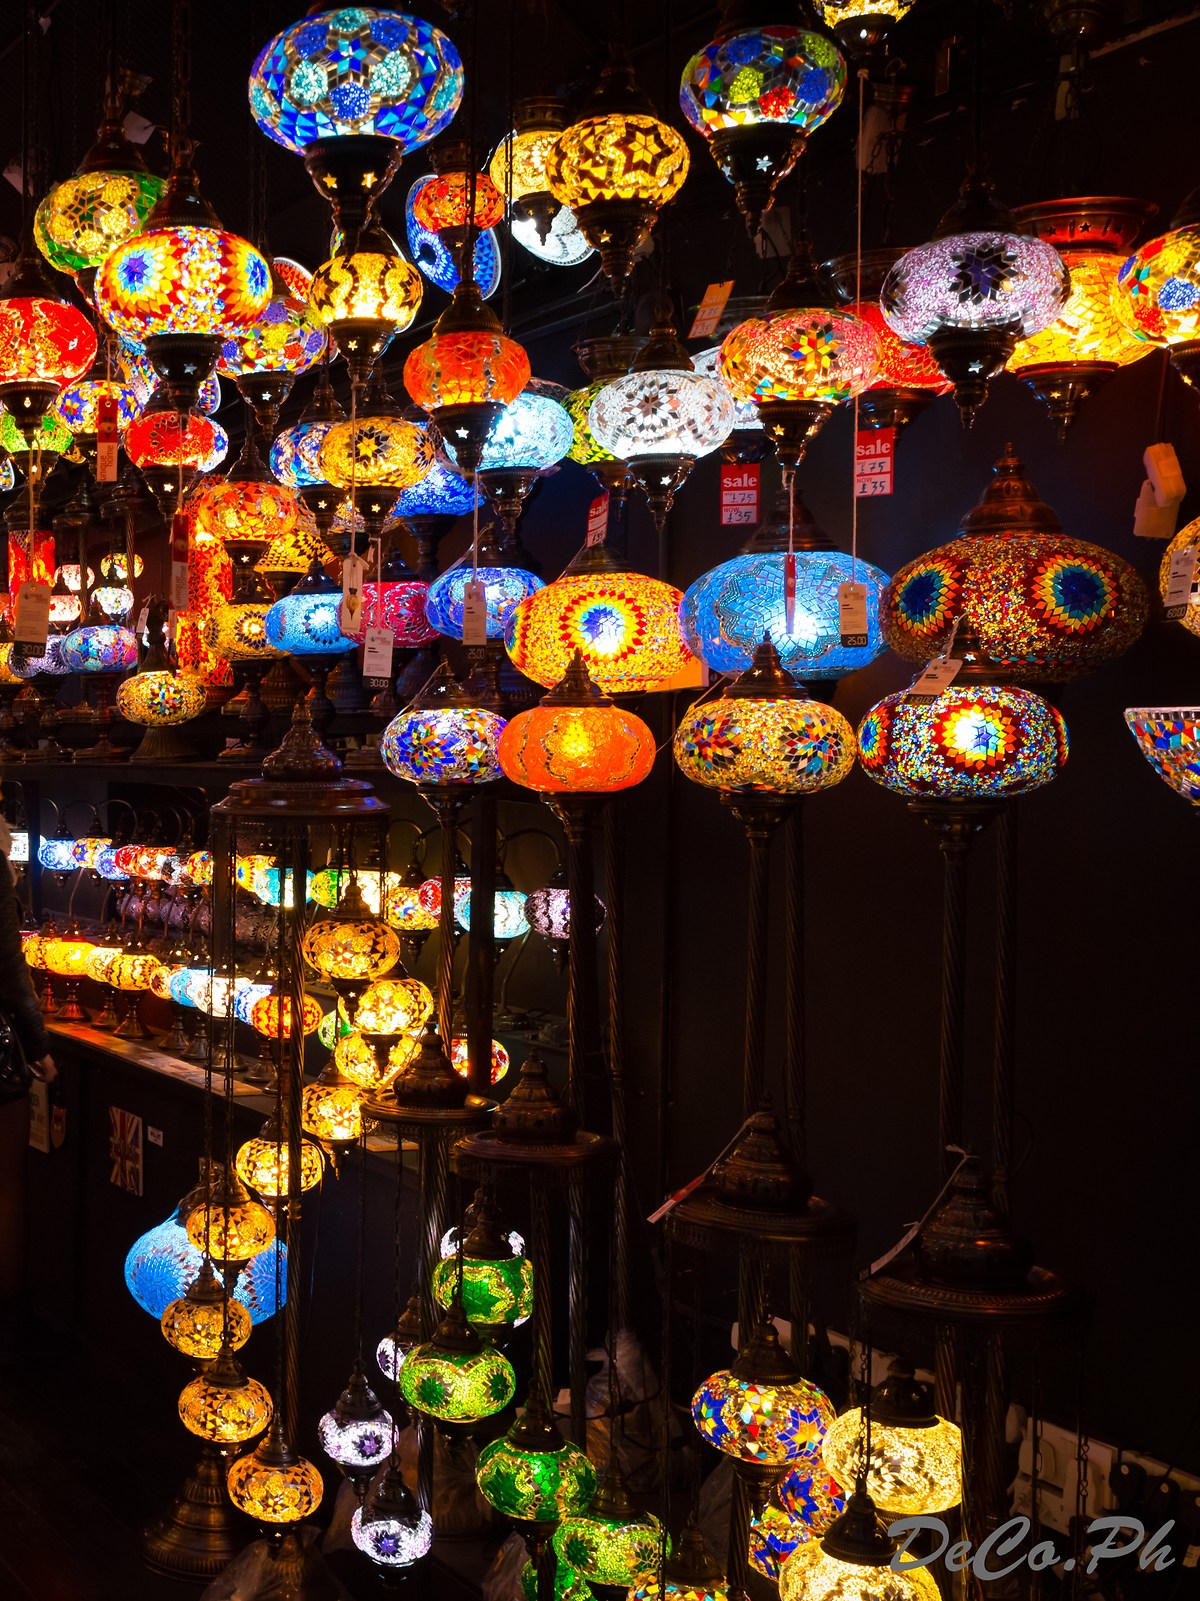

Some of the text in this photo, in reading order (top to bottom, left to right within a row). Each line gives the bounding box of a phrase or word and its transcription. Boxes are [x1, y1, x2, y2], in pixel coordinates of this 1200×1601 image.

[857, 439, 891, 457] sale
[106, 446, 114, 467] home
[723, 473, 757, 488] sale
[859, 481, 886, 495] £35
[729, 493, 754, 504] £75
[727, 511, 752, 523] £35
[370, 678, 389, 688] 30.00
